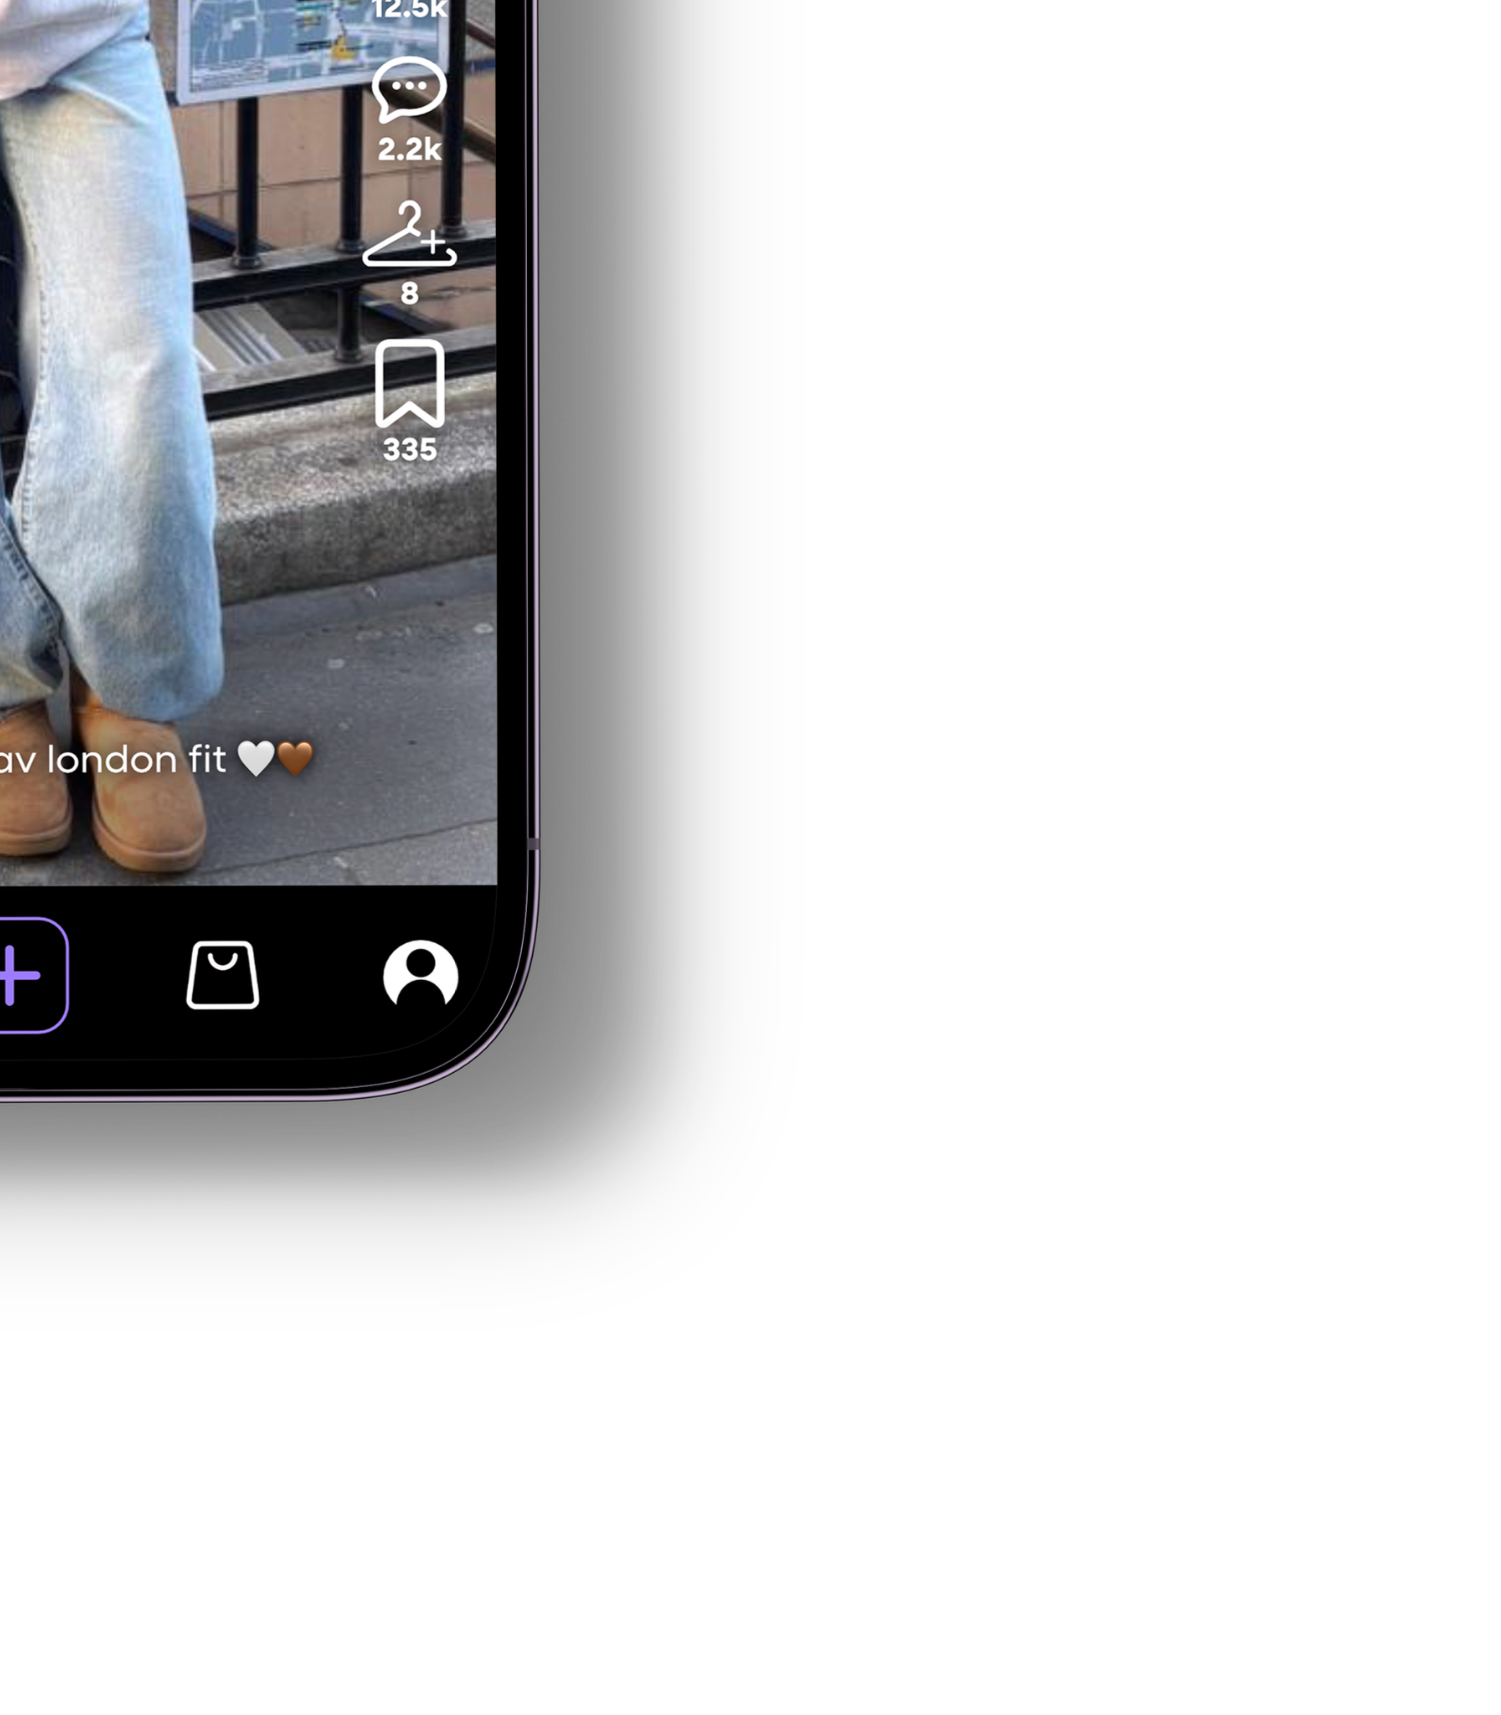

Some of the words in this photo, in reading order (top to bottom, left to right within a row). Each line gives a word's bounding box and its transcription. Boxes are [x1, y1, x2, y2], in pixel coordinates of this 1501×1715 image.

[378, 136, 443, 161] 2.2k
[401, 281, 419, 305] 8
[383, 437, 438, 462] 335
[49, 743, 176, 774] london
[188, 743, 226, 774] fit
